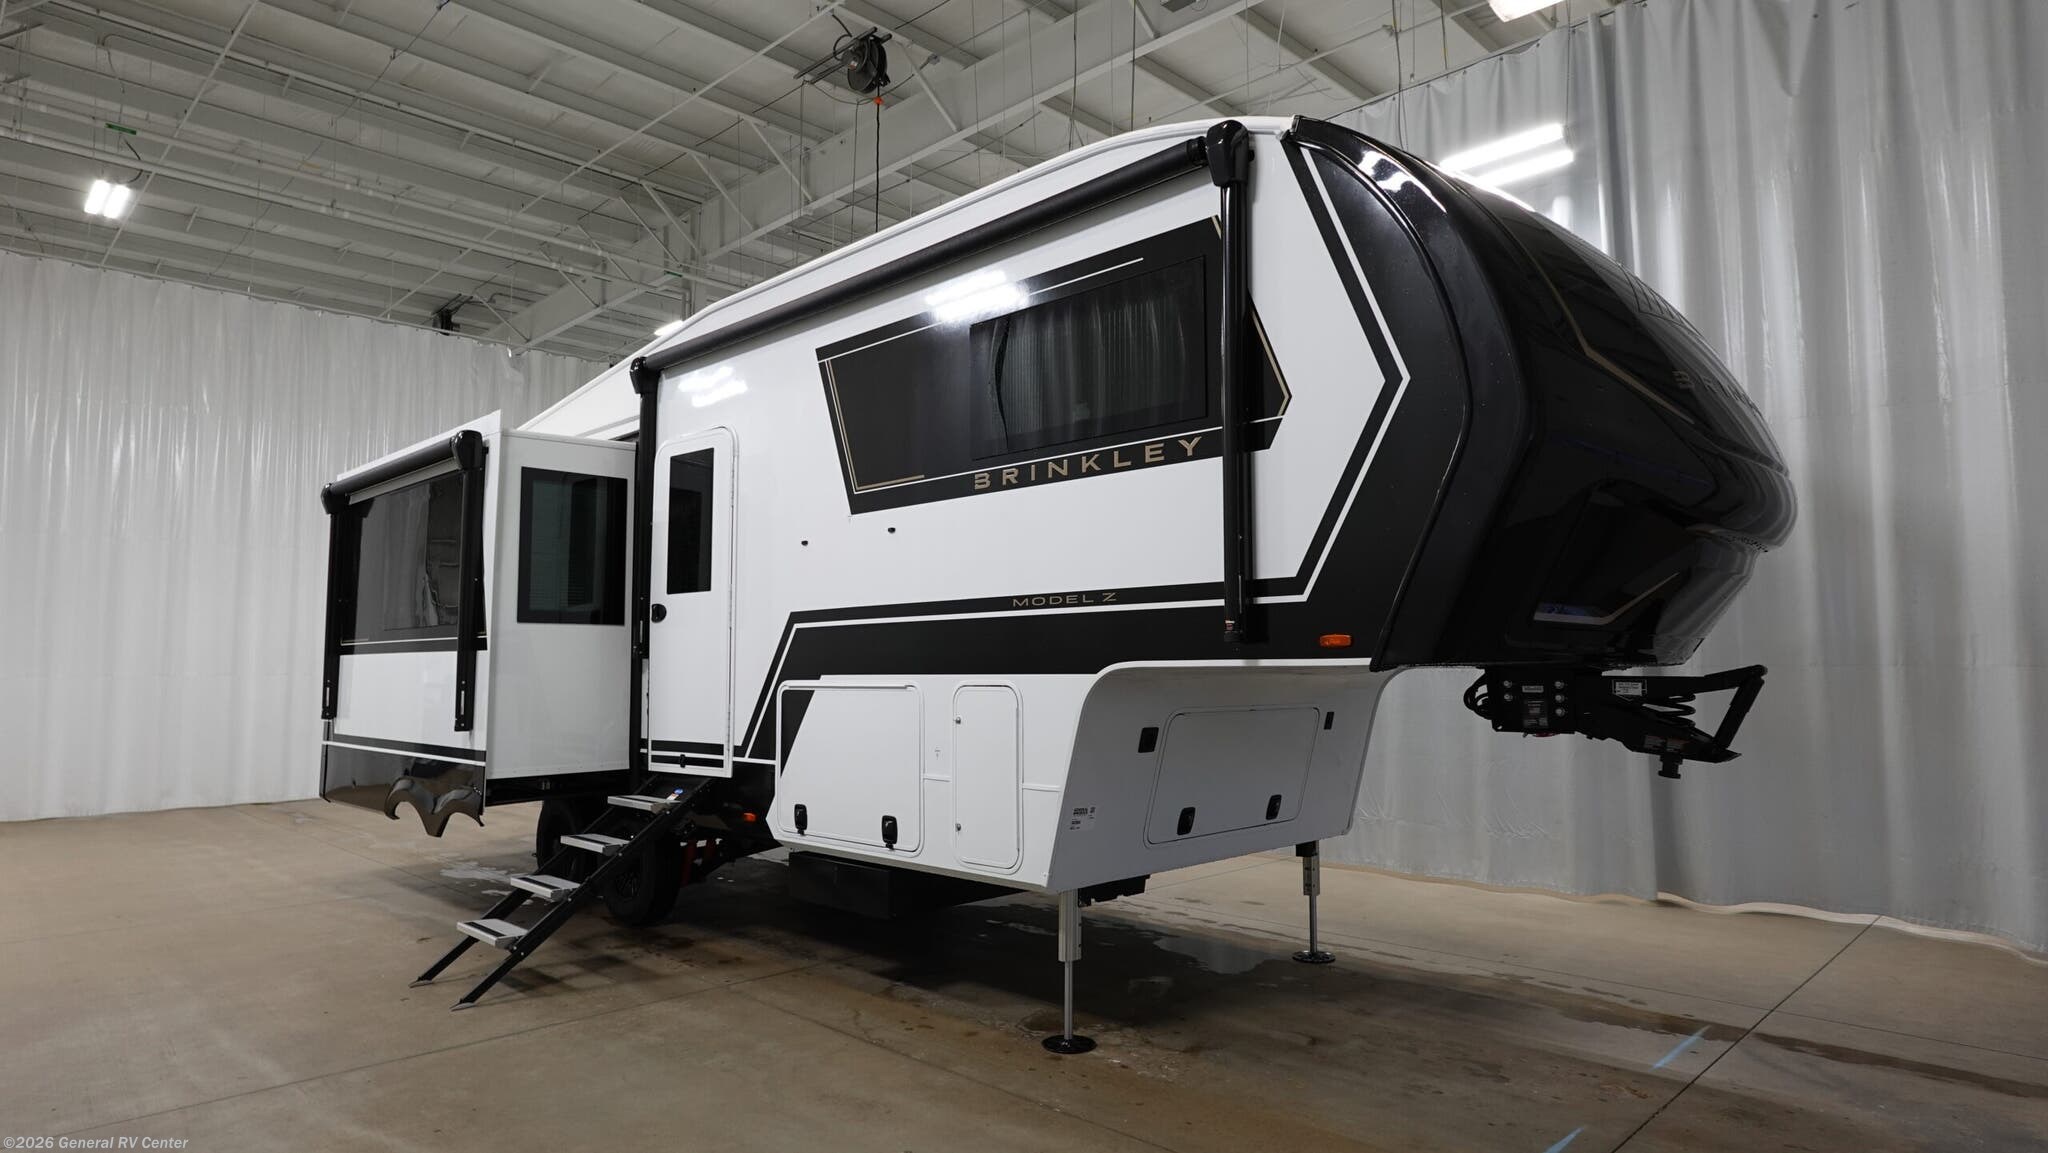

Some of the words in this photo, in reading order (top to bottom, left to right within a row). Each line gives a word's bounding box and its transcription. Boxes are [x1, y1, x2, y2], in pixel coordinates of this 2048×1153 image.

[974, 437, 1202, 490] BRINKLEY
[1012, 594, 1094, 607] MODEL
[1102, 592, 1117, 602] Z
